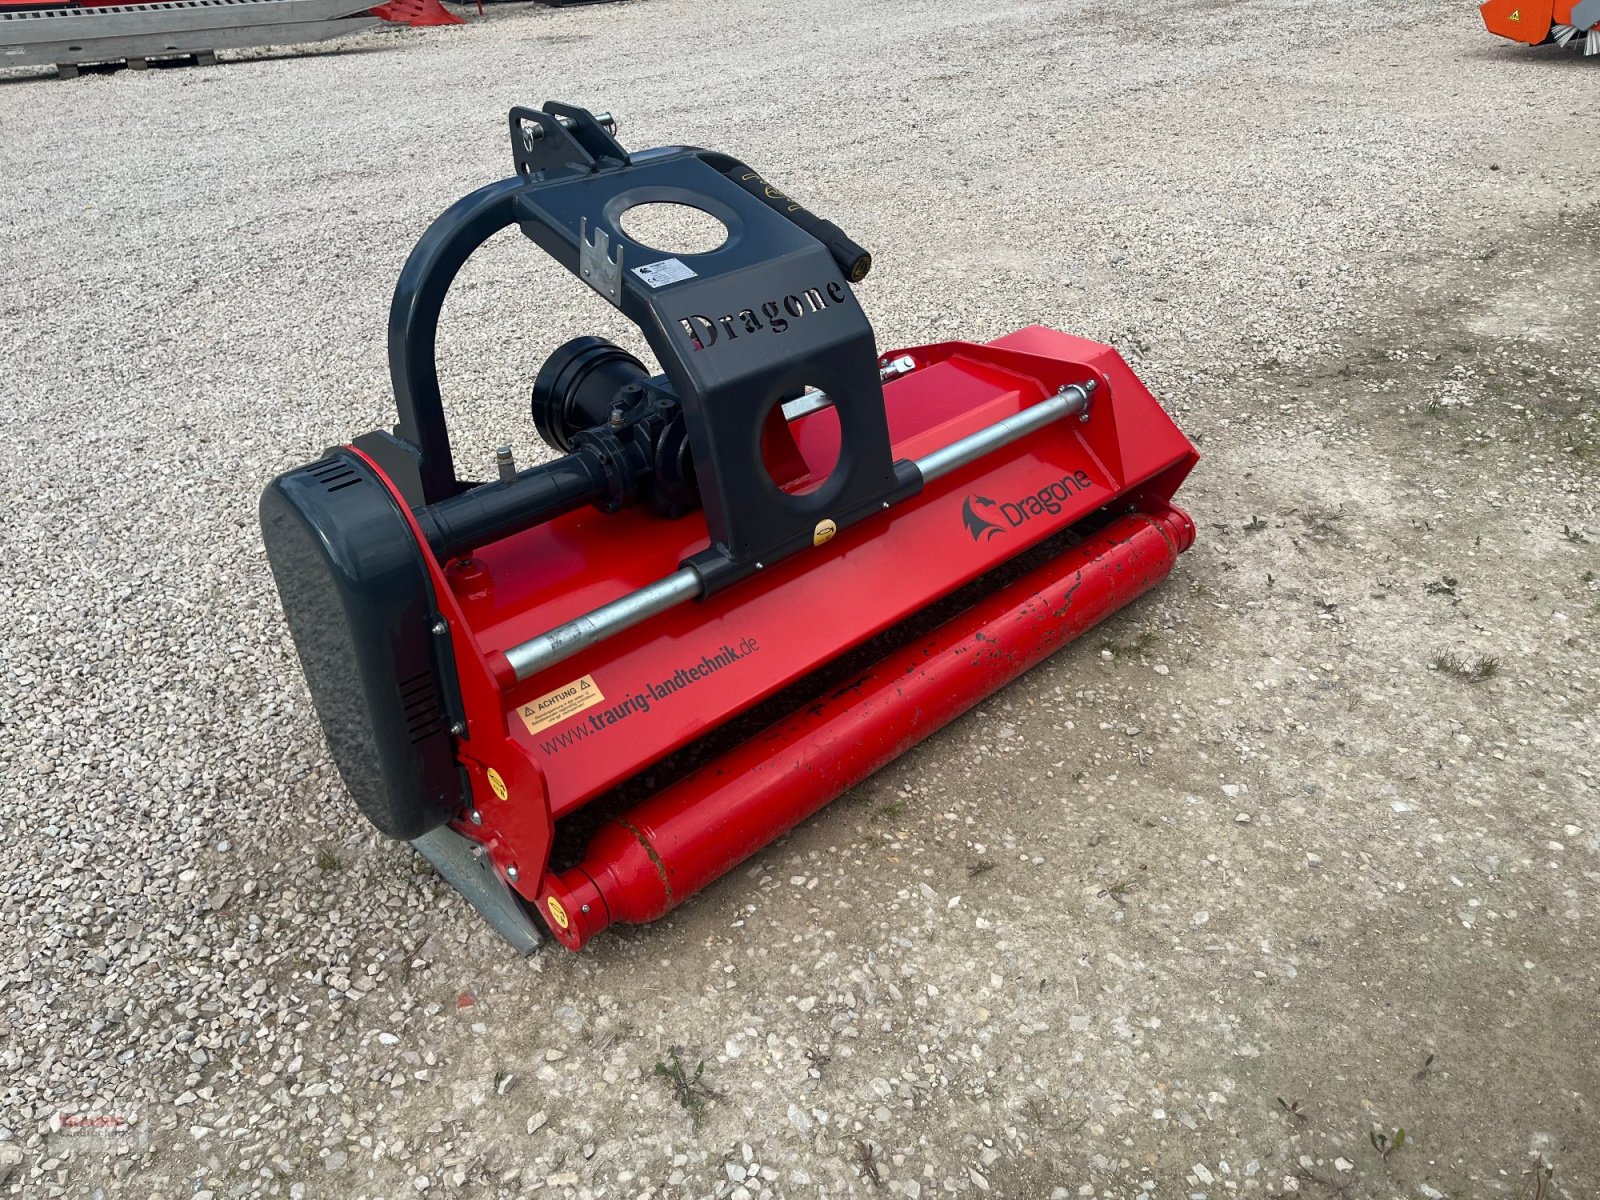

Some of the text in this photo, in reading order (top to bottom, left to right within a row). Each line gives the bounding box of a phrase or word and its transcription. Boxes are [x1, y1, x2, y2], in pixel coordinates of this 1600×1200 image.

[678, 282, 846, 352] Dragone
[999, 470, 1092, 528] Dragone
[538, 687, 577, 711] ACHTUNG
[540, 635, 760, 756] www.traurig-landtechnik.de
